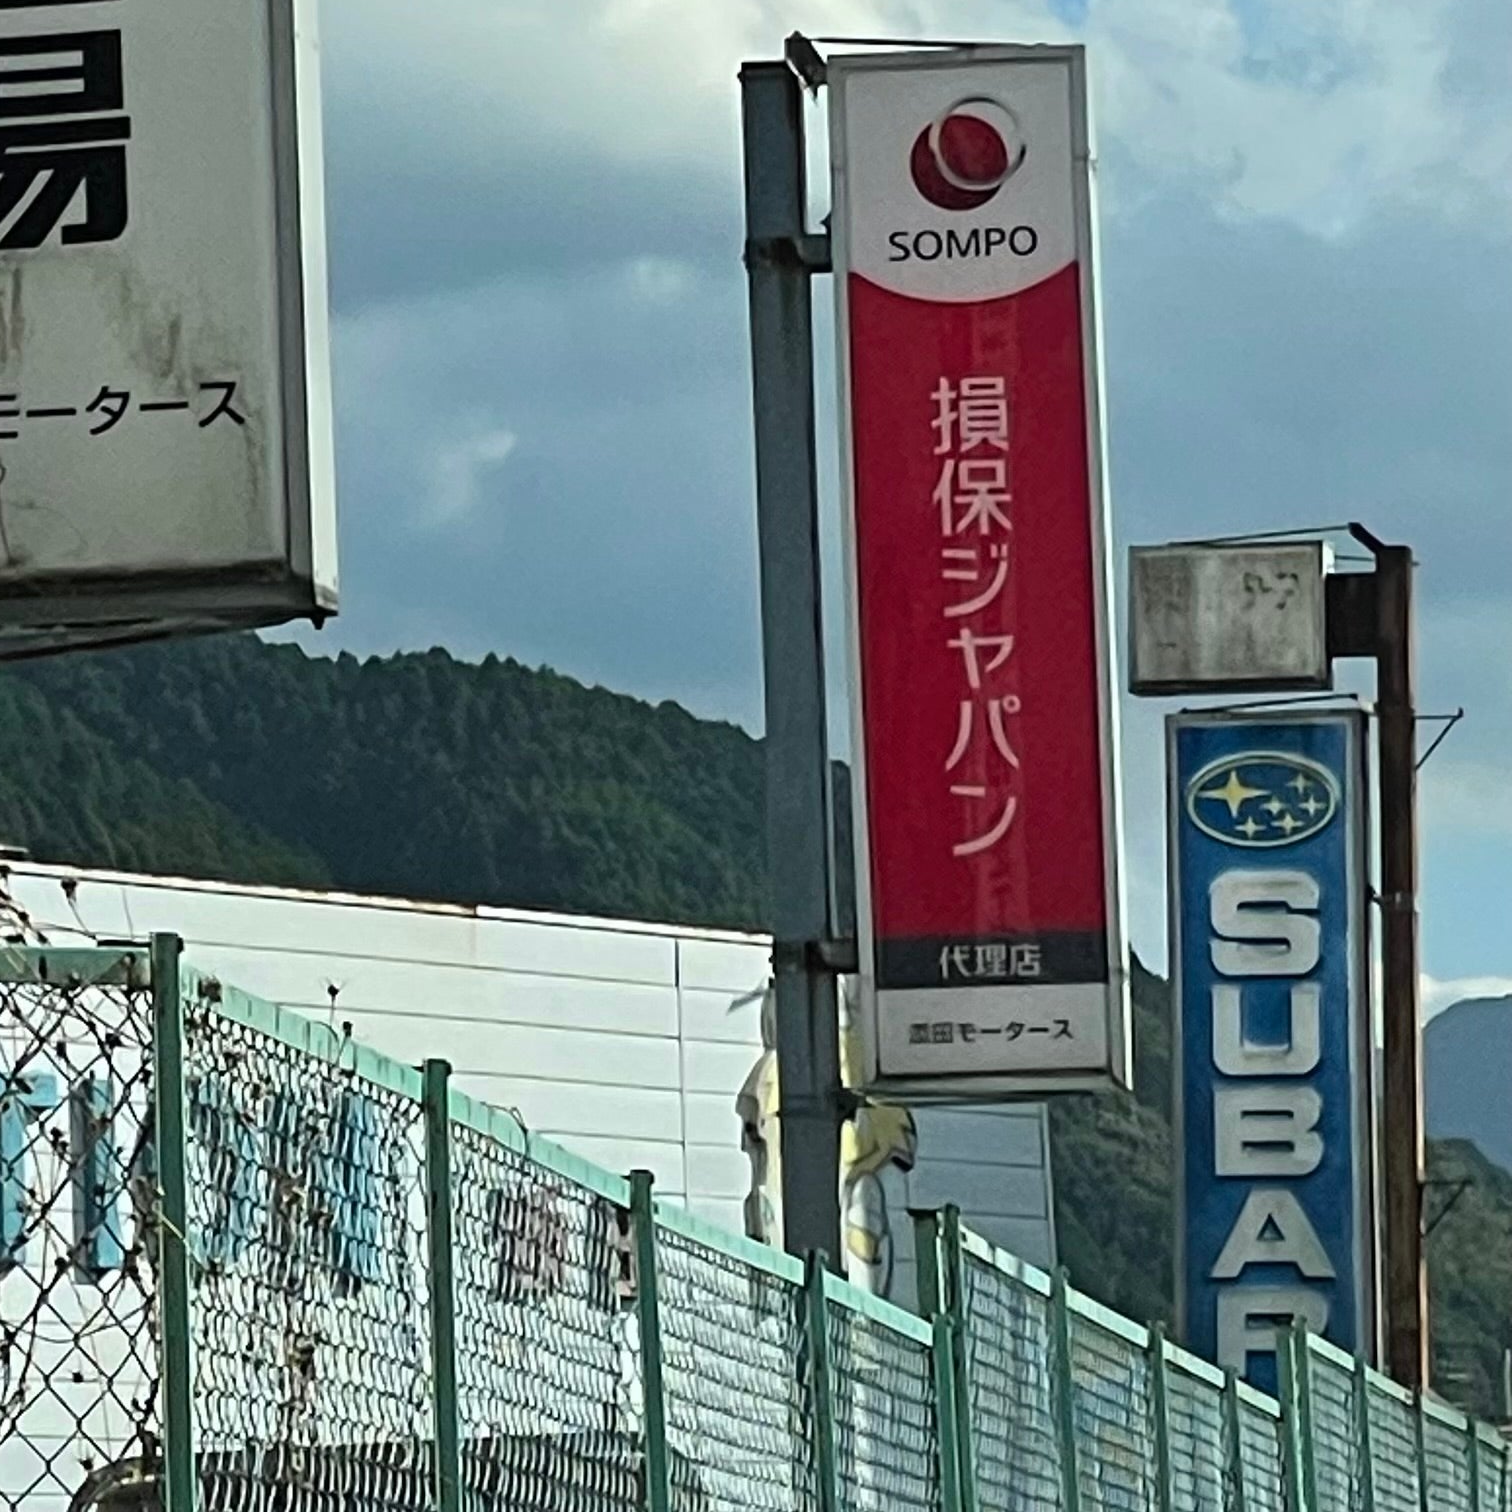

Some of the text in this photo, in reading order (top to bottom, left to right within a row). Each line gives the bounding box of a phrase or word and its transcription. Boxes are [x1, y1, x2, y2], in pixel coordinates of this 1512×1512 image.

[888, 225, 1038, 262] SOMPO
[939, 944, 1041, 979] 代理店
